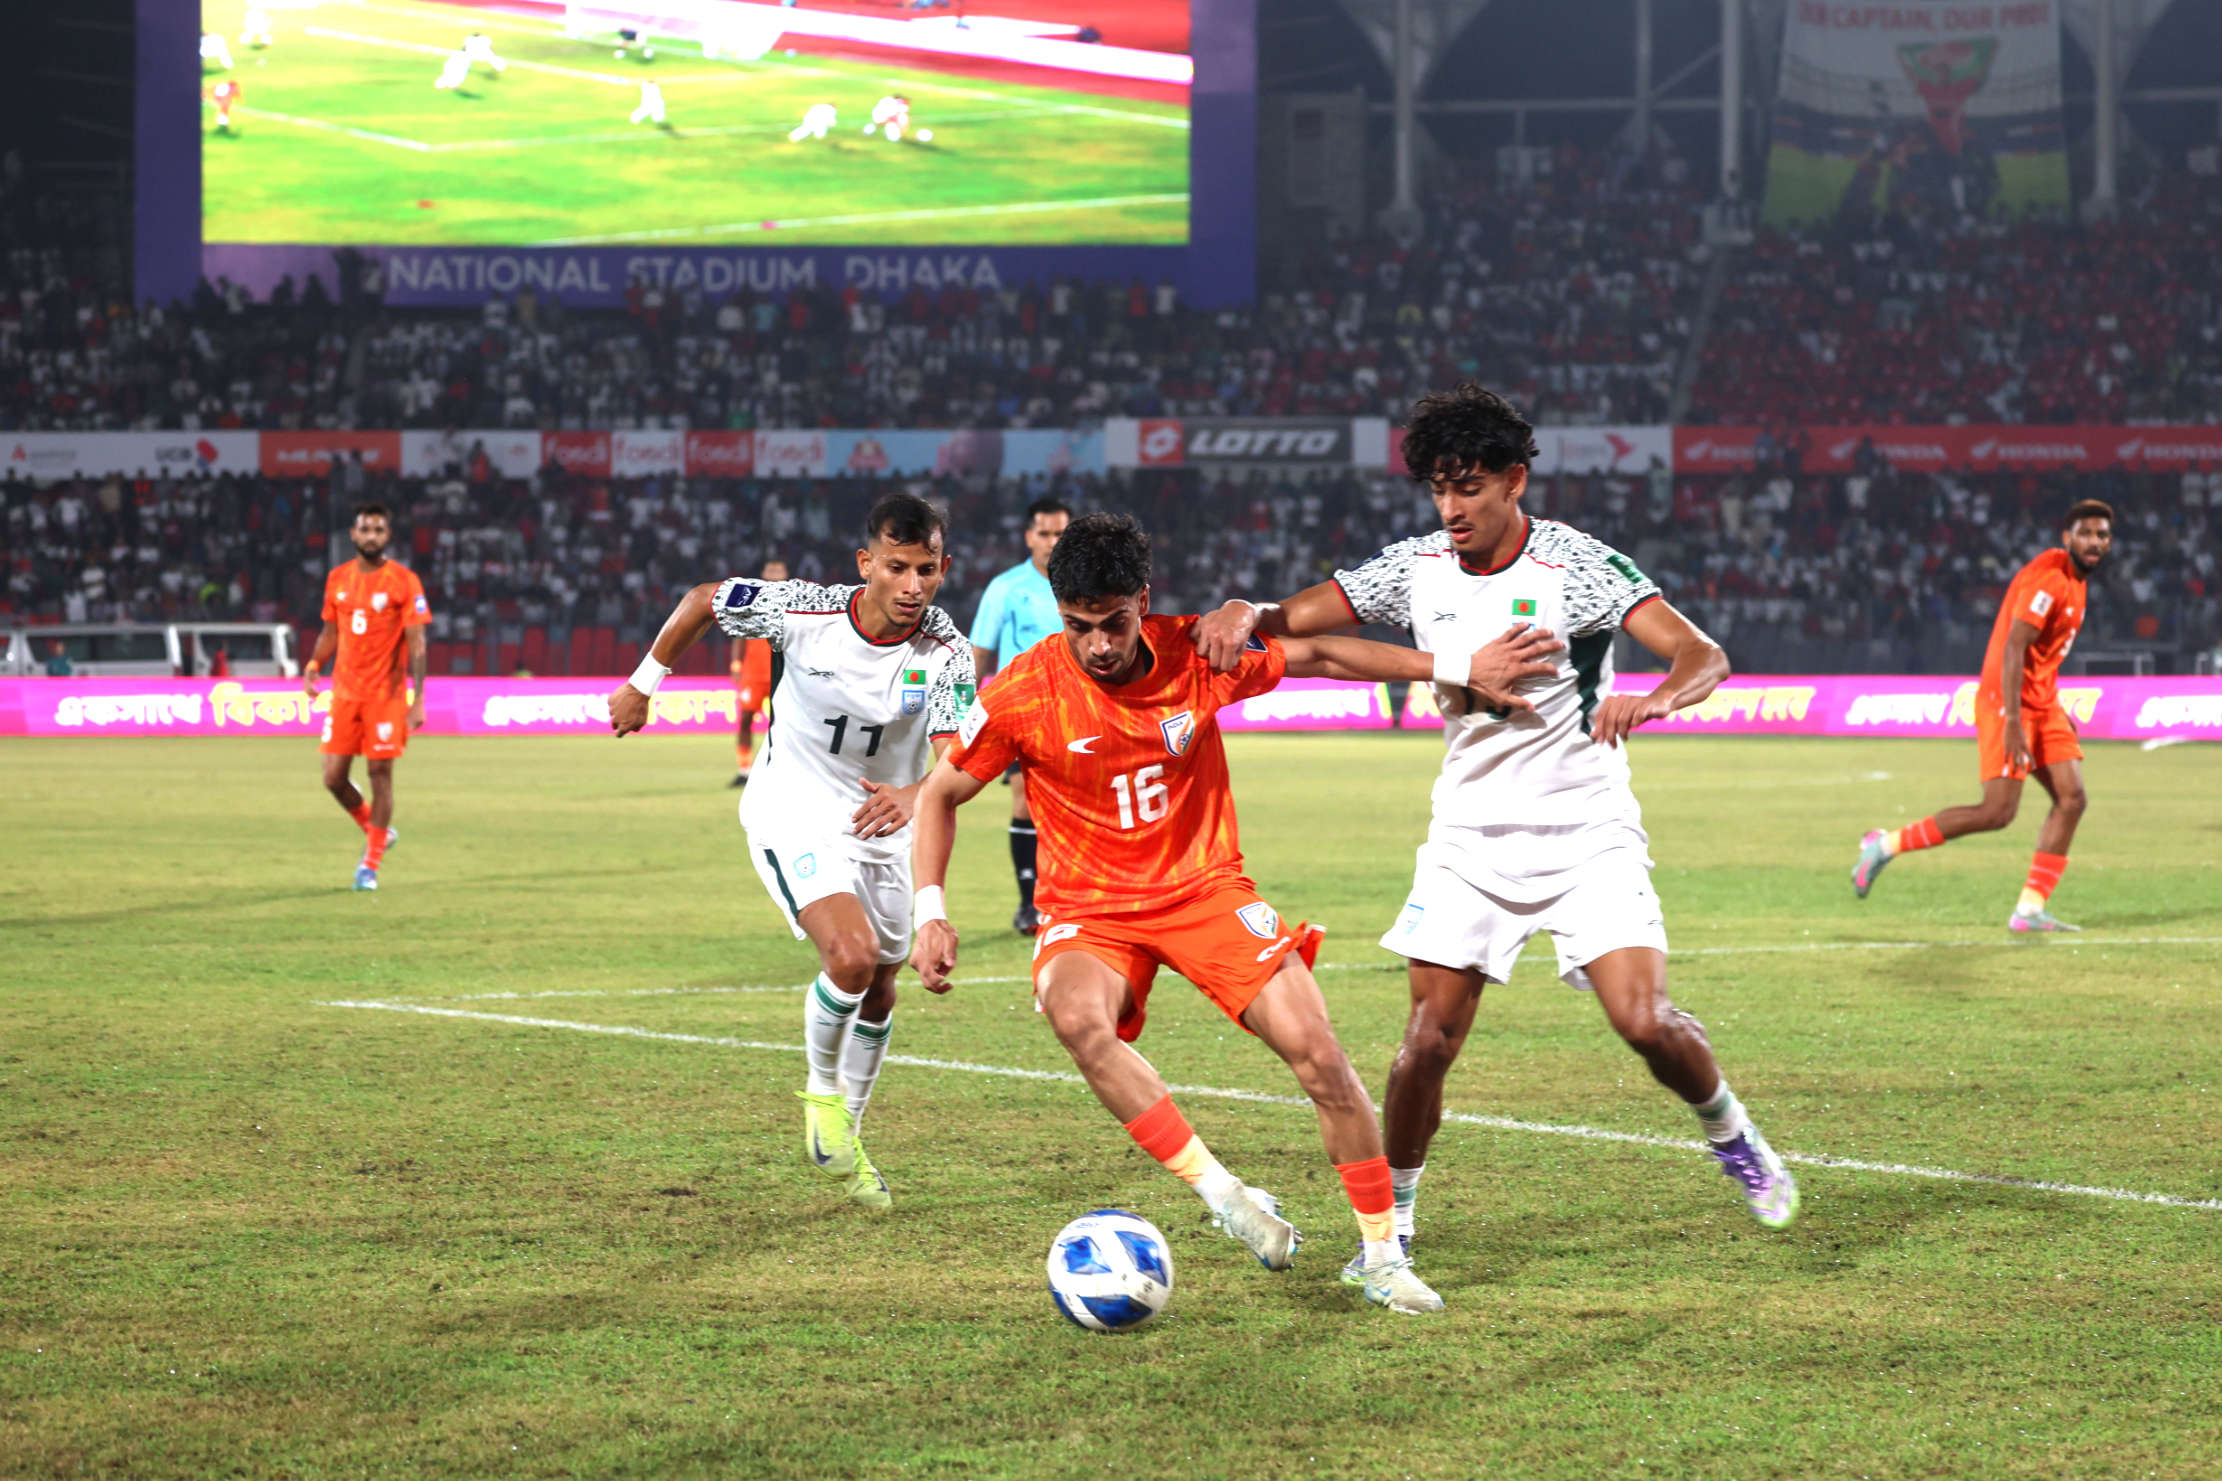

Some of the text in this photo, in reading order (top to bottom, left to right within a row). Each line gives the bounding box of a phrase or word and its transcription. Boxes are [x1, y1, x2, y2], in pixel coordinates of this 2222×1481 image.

[389, 254, 1000, 293] NATIONAL STADIUM DHAKA
[1187, 429, 1339, 456] LOTTO
[1997, 444, 2089, 462] HONDA
[2143, 444, 2222, 462] HOND
[351, 608, 368, 635] 6
[823, 714, 885, 758] 11
[1109, 763, 1170, 830] 16
